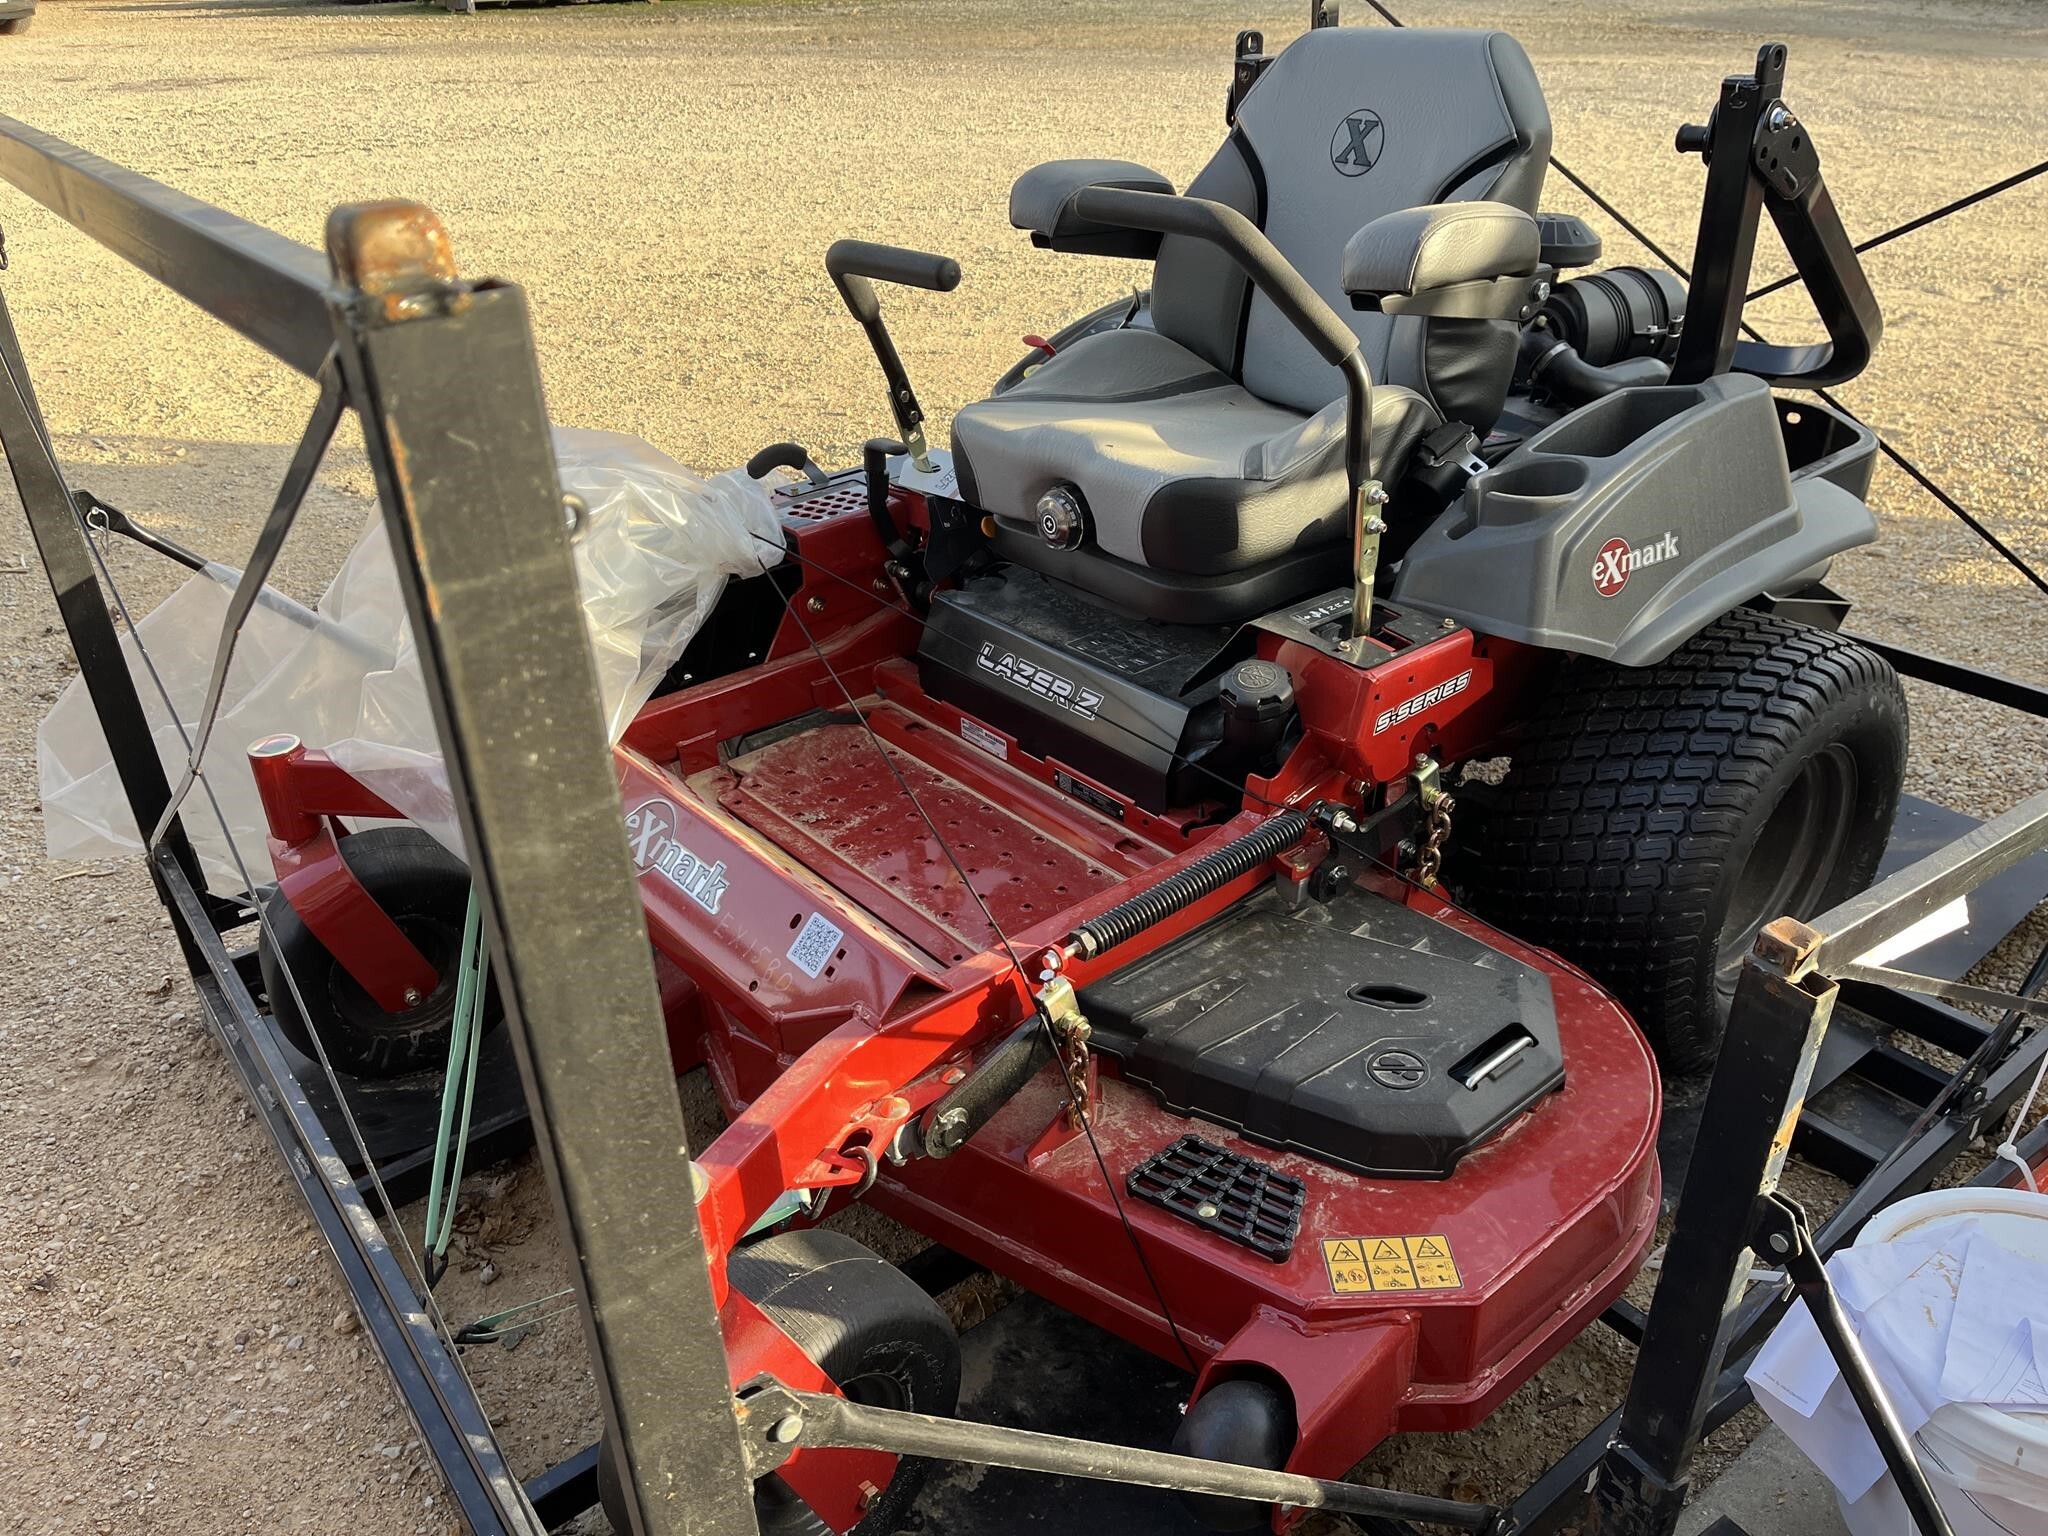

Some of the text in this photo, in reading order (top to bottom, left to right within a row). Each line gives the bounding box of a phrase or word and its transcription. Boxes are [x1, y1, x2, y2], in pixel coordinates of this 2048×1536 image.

[1591, 531, 1680, 589] eXmark
[977, 642, 1105, 721] LAZER Z
[1373, 669, 1472, 736] S-SERIES
[713, 911, 794, 991] EX1580
